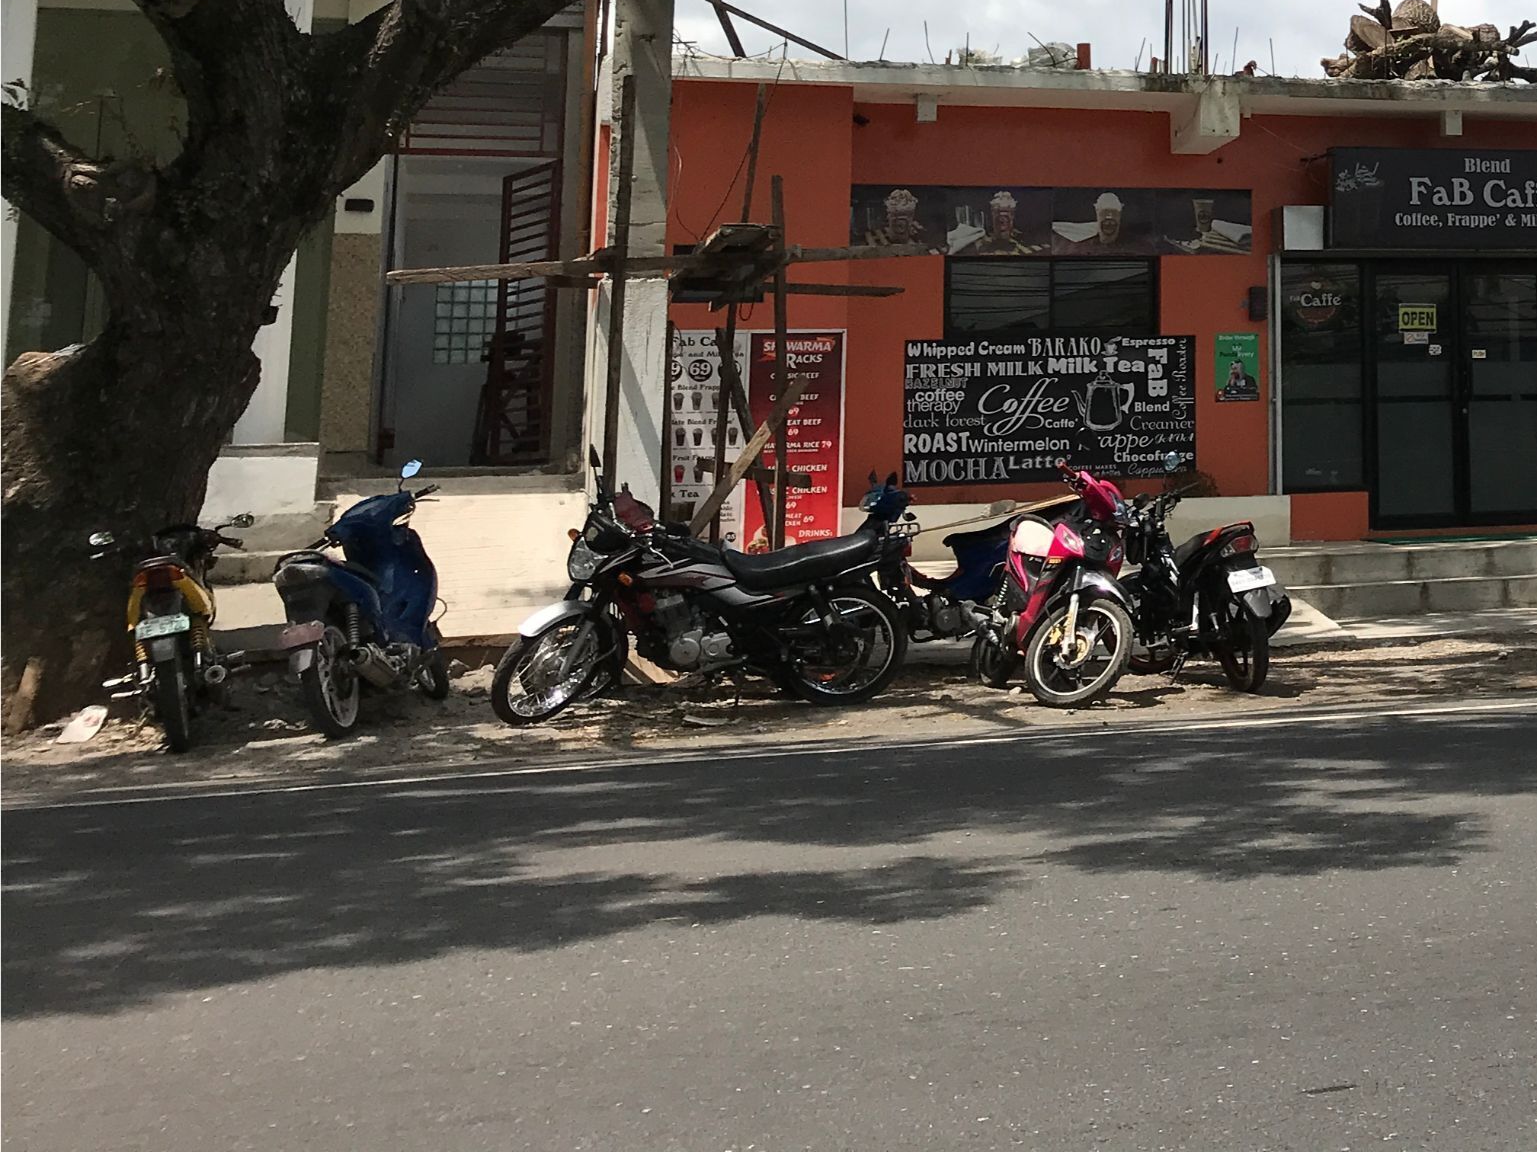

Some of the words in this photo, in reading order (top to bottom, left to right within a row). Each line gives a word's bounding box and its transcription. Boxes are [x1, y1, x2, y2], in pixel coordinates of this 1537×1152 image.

[1464, 158, 1511, 173] Blend
[1409, 176, 1474, 206] FaB
[1395, 212, 1443, 228] Coffee,
[1447, 213, 1500, 228] Frappe'
[1505, 214, 1517, 227] &
[1402, 312, 1433, 326] OPEN
[763, 341, 832, 352] SHWARMA
[907, 341, 975, 359] Whipped
[978, 341, 1025, 355] Cream
[1028, 337, 1100, 356] BARAKO
[1121, 338, 1175, 348] Espresso
[672, 362, 680, 376] 9
[688, 362, 712, 376] 69
[905, 362, 981, 378] FRESH
[987, 360, 1043, 376] MILK
[1047, 357, 1098, 374] Milk
[1103, 356, 1145, 373] Tea
[1147, 347, 1168, 397] FaB
[904, 377, 969, 390] HAZELNUT
[915, 388, 965, 402] coffee
[1172, 384, 1194, 419] Coffee
[907, 399, 961, 414] therapy
[977, 377, 1070, 437] Coffee
[1134, 401, 1170, 413] Blend
[903, 413, 940, 428] dark
[945, 412, 988, 427] forest
[1130, 415, 1195, 431] Creamer
[788, 428, 799, 436] 69
[904, 431, 970, 454] ROAST
[969, 437, 1070, 453] Wintermelon
[792, 464, 828, 472] CHICKEN
[904, 456, 1010, 483] MOCHA
[679, 489, 699, 498] Tea
[792, 486, 828, 494] CHICKEN
[786, 501, 797, 509] 69
[803, 515, 815, 523] 69
